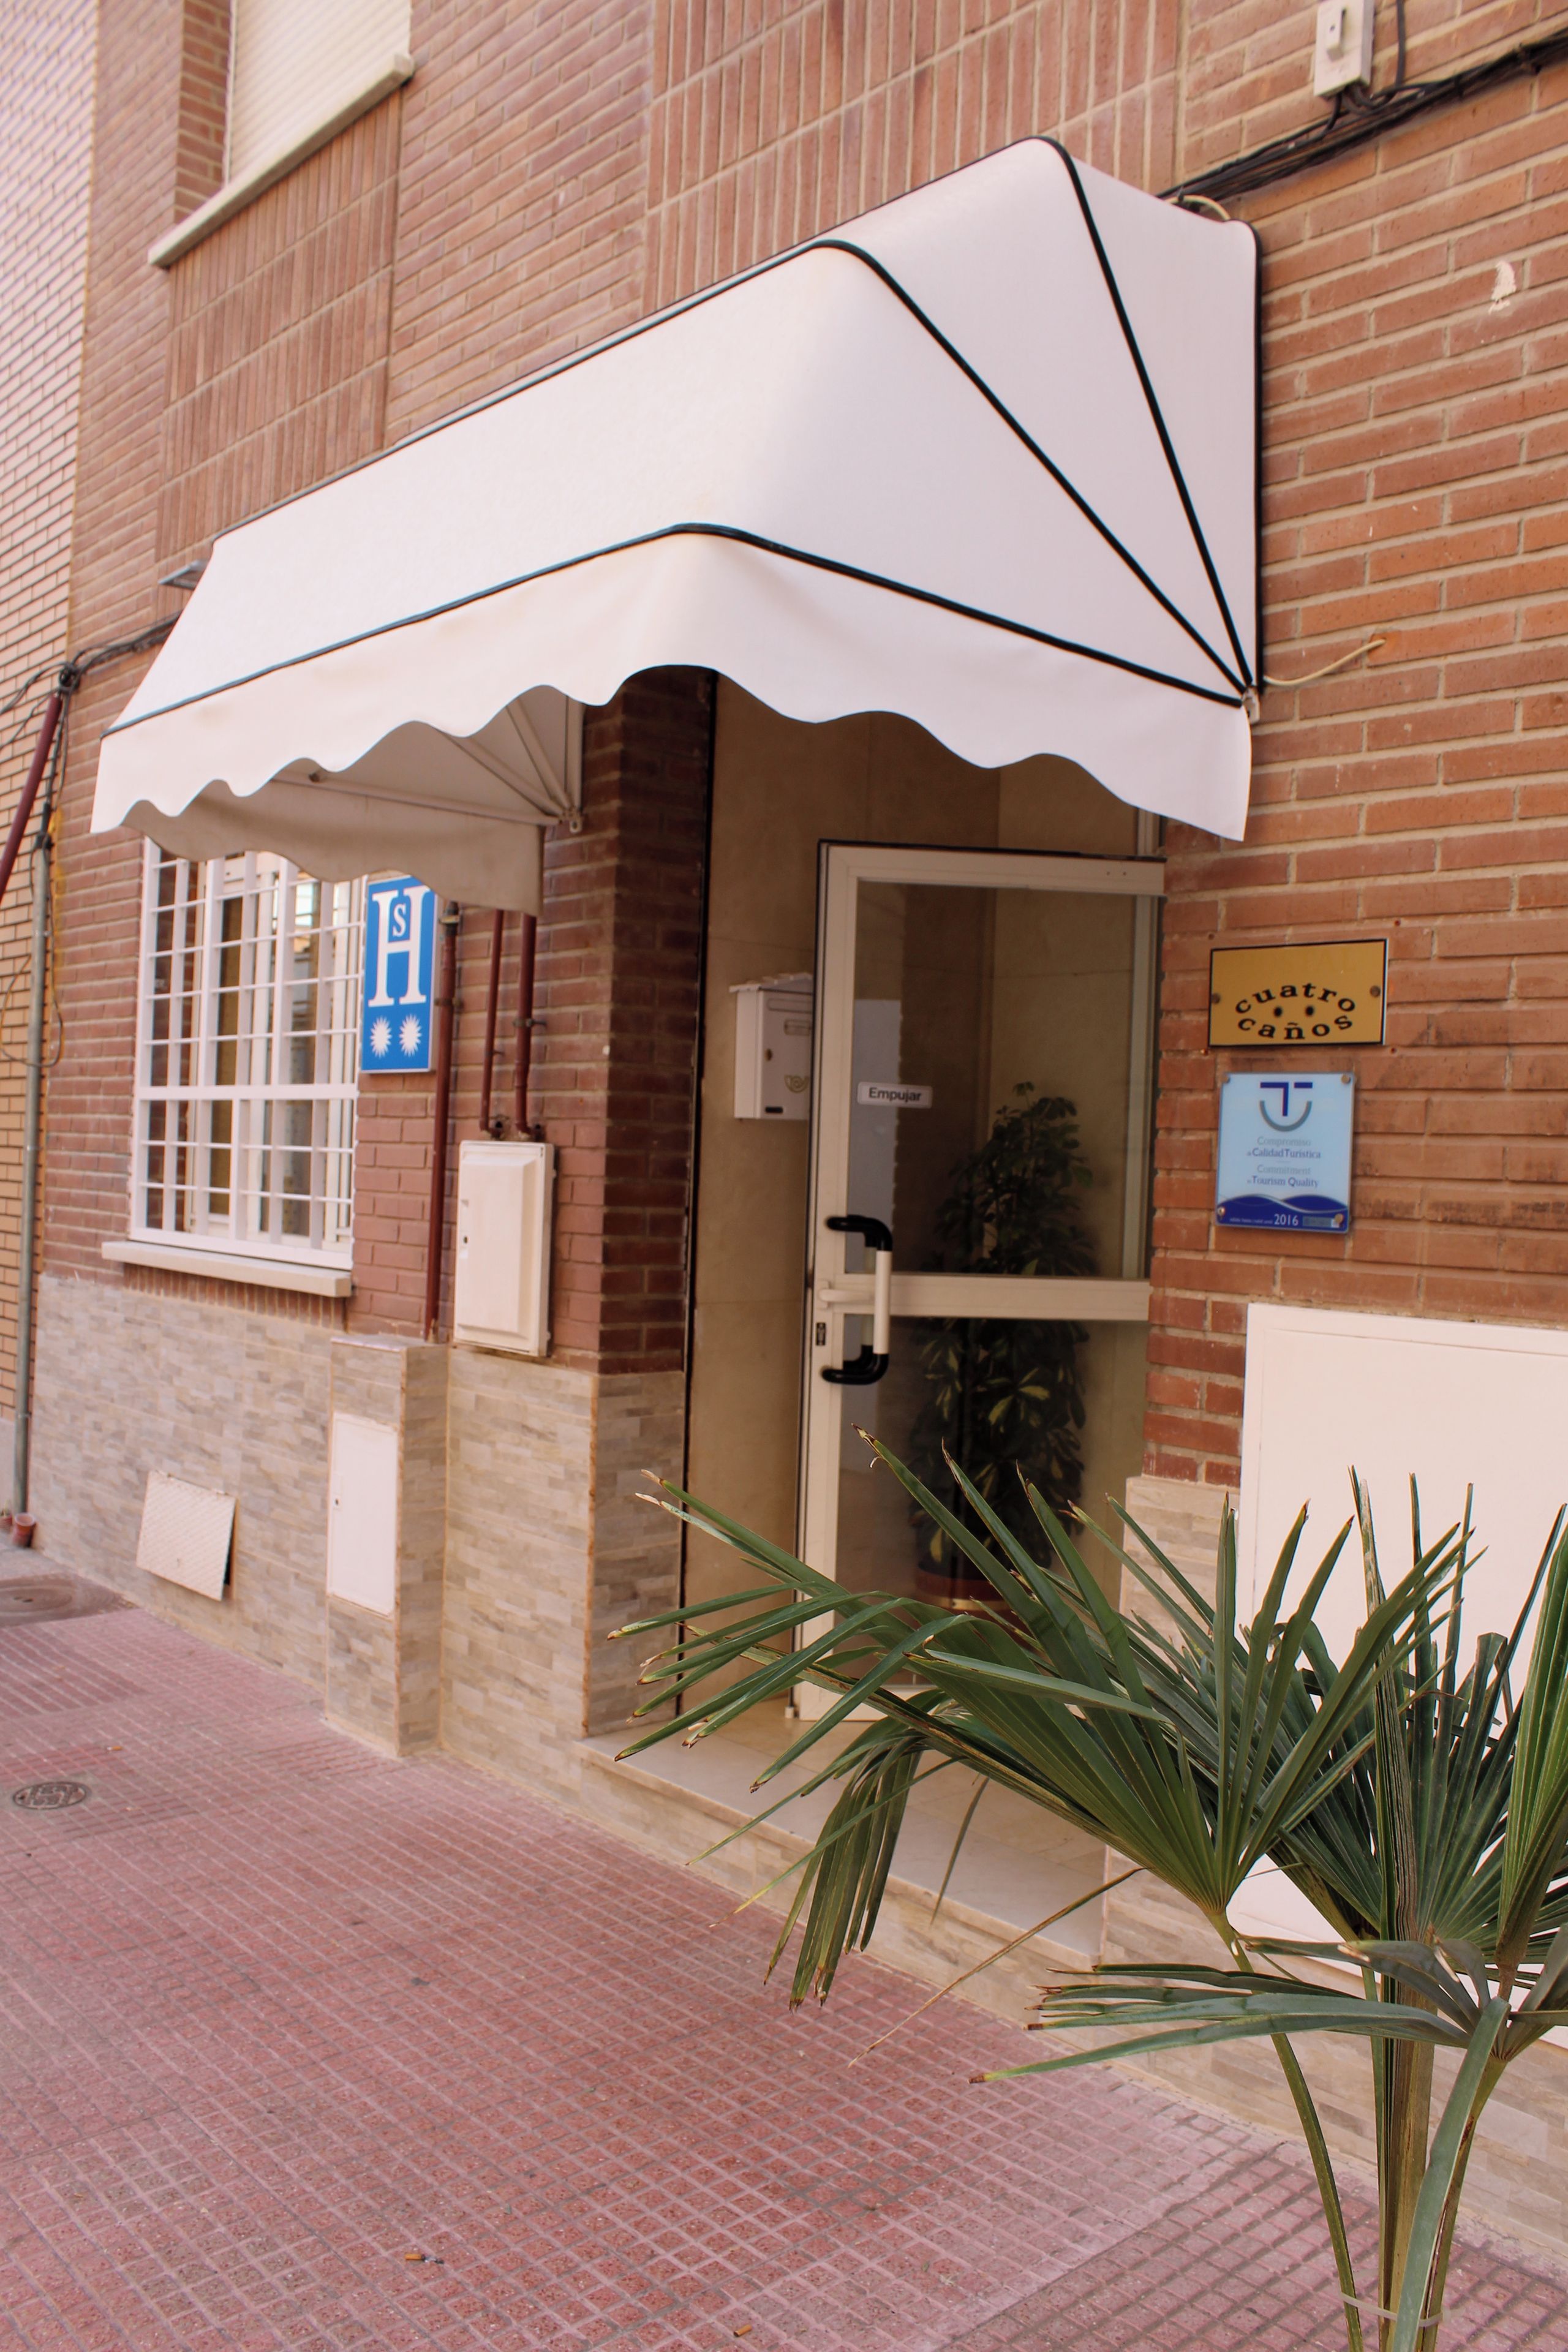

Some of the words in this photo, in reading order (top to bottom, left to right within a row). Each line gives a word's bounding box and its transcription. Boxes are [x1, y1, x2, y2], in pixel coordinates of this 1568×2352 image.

[1235, 983, 1355, 1013] cuatro
[1238, 1015, 1353, 1040] caños
[869, 1087, 921, 1102] Empujar
[1257, 1136, 1311, 1147] Compromiso
[1252, 1148, 1284, 1157] Calidad
[1257, 1164, 1311, 1175] Commitment
[1252, 1175, 1286, 1185] Tourism
[1287, 1177, 1318, 1188] Quality
[1274, 1213, 1298, 1226] 2016
